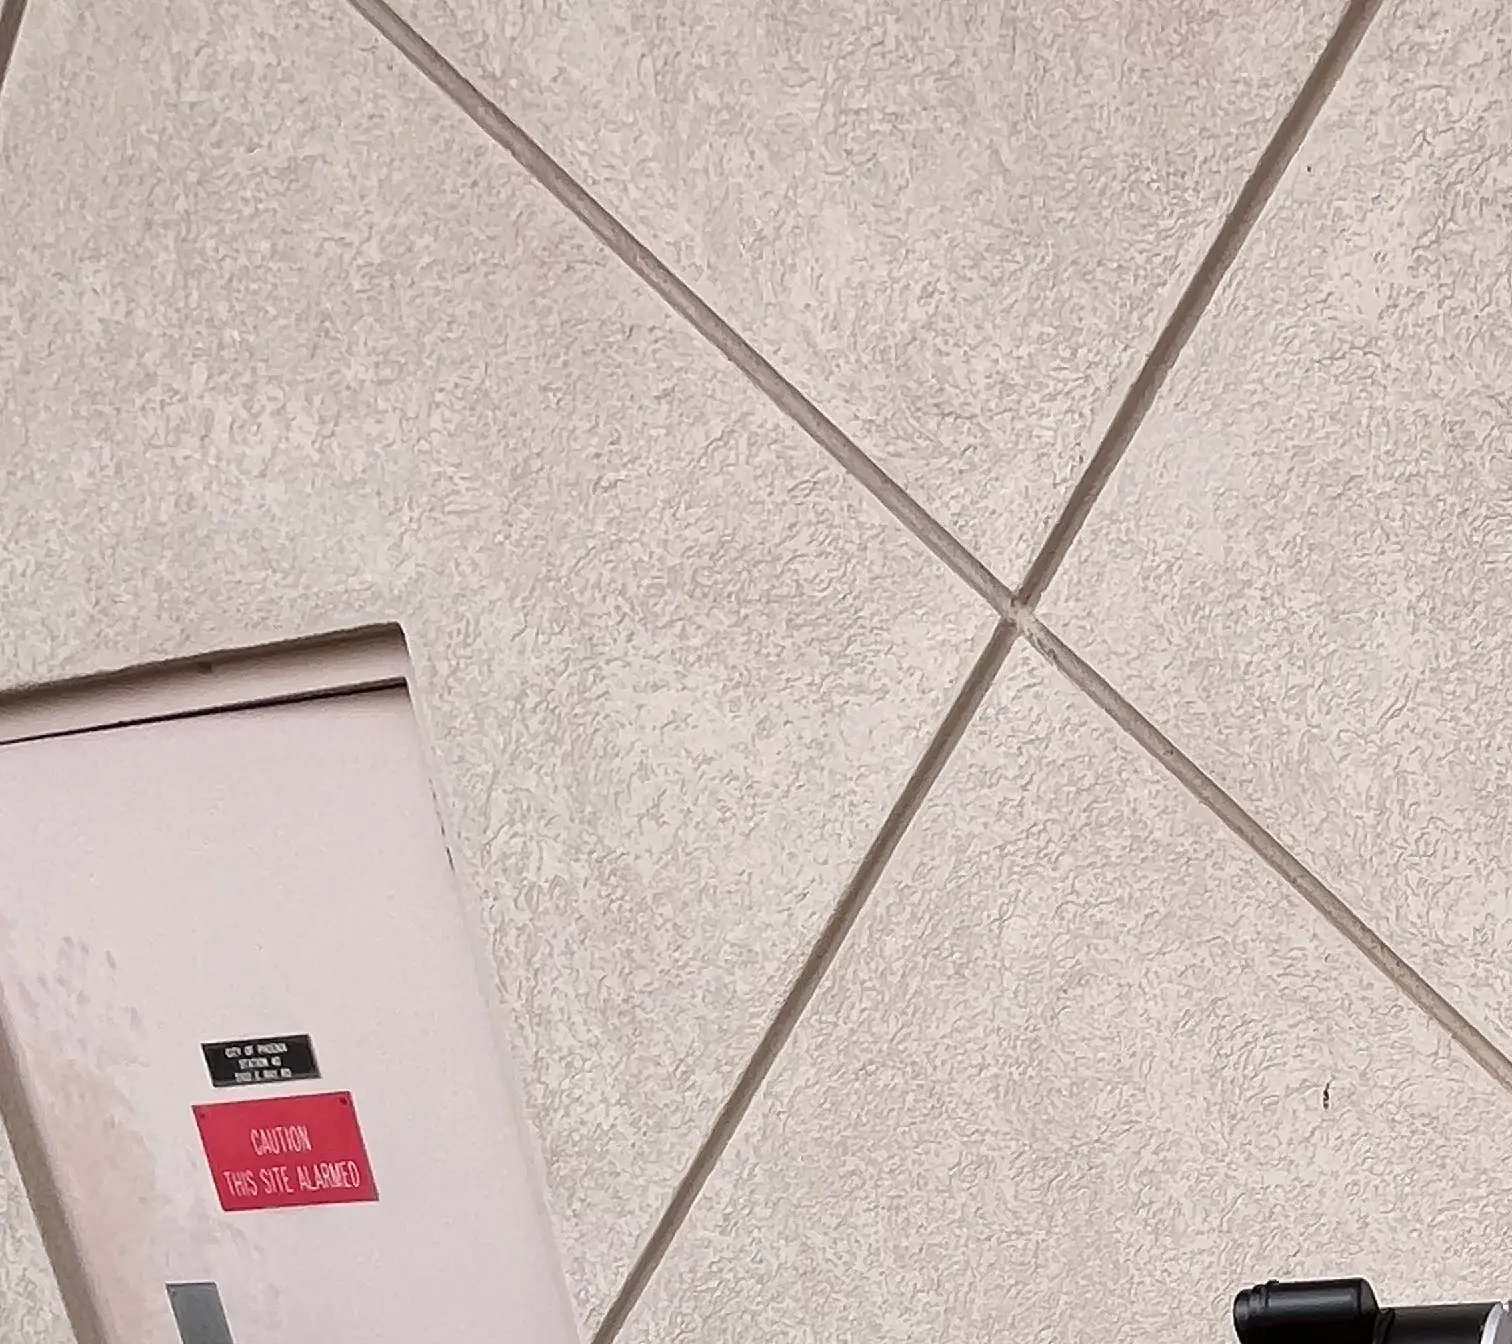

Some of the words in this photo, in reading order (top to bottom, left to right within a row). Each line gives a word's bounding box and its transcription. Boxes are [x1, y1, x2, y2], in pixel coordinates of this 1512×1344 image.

[250, 1125, 312, 1156] CAUTION
[223, 1170, 259, 1197] THIS
[259, 1168, 294, 1195] SITE
[297, 1160, 361, 1191] ALARMED
